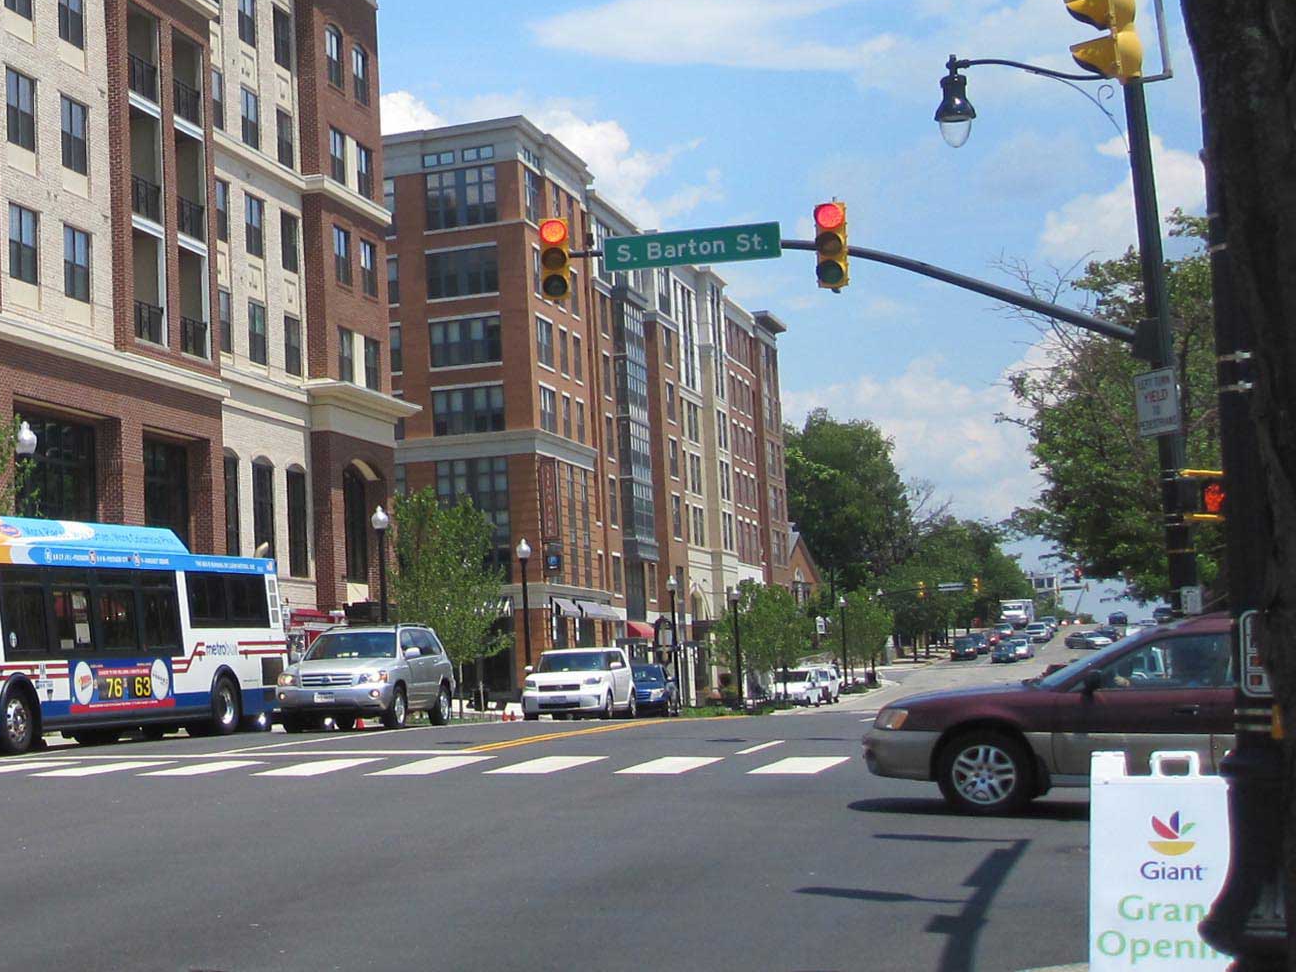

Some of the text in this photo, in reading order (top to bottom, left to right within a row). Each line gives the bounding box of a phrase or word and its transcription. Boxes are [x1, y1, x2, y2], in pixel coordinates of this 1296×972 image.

[616, 233, 768, 262] S. Barton St.
[106, 677, 122, 698] 76
[135, 676, 151, 696] 63
[1140, 861, 1203, 881] Giant
[1117, 894, 1206, 922] Gran
